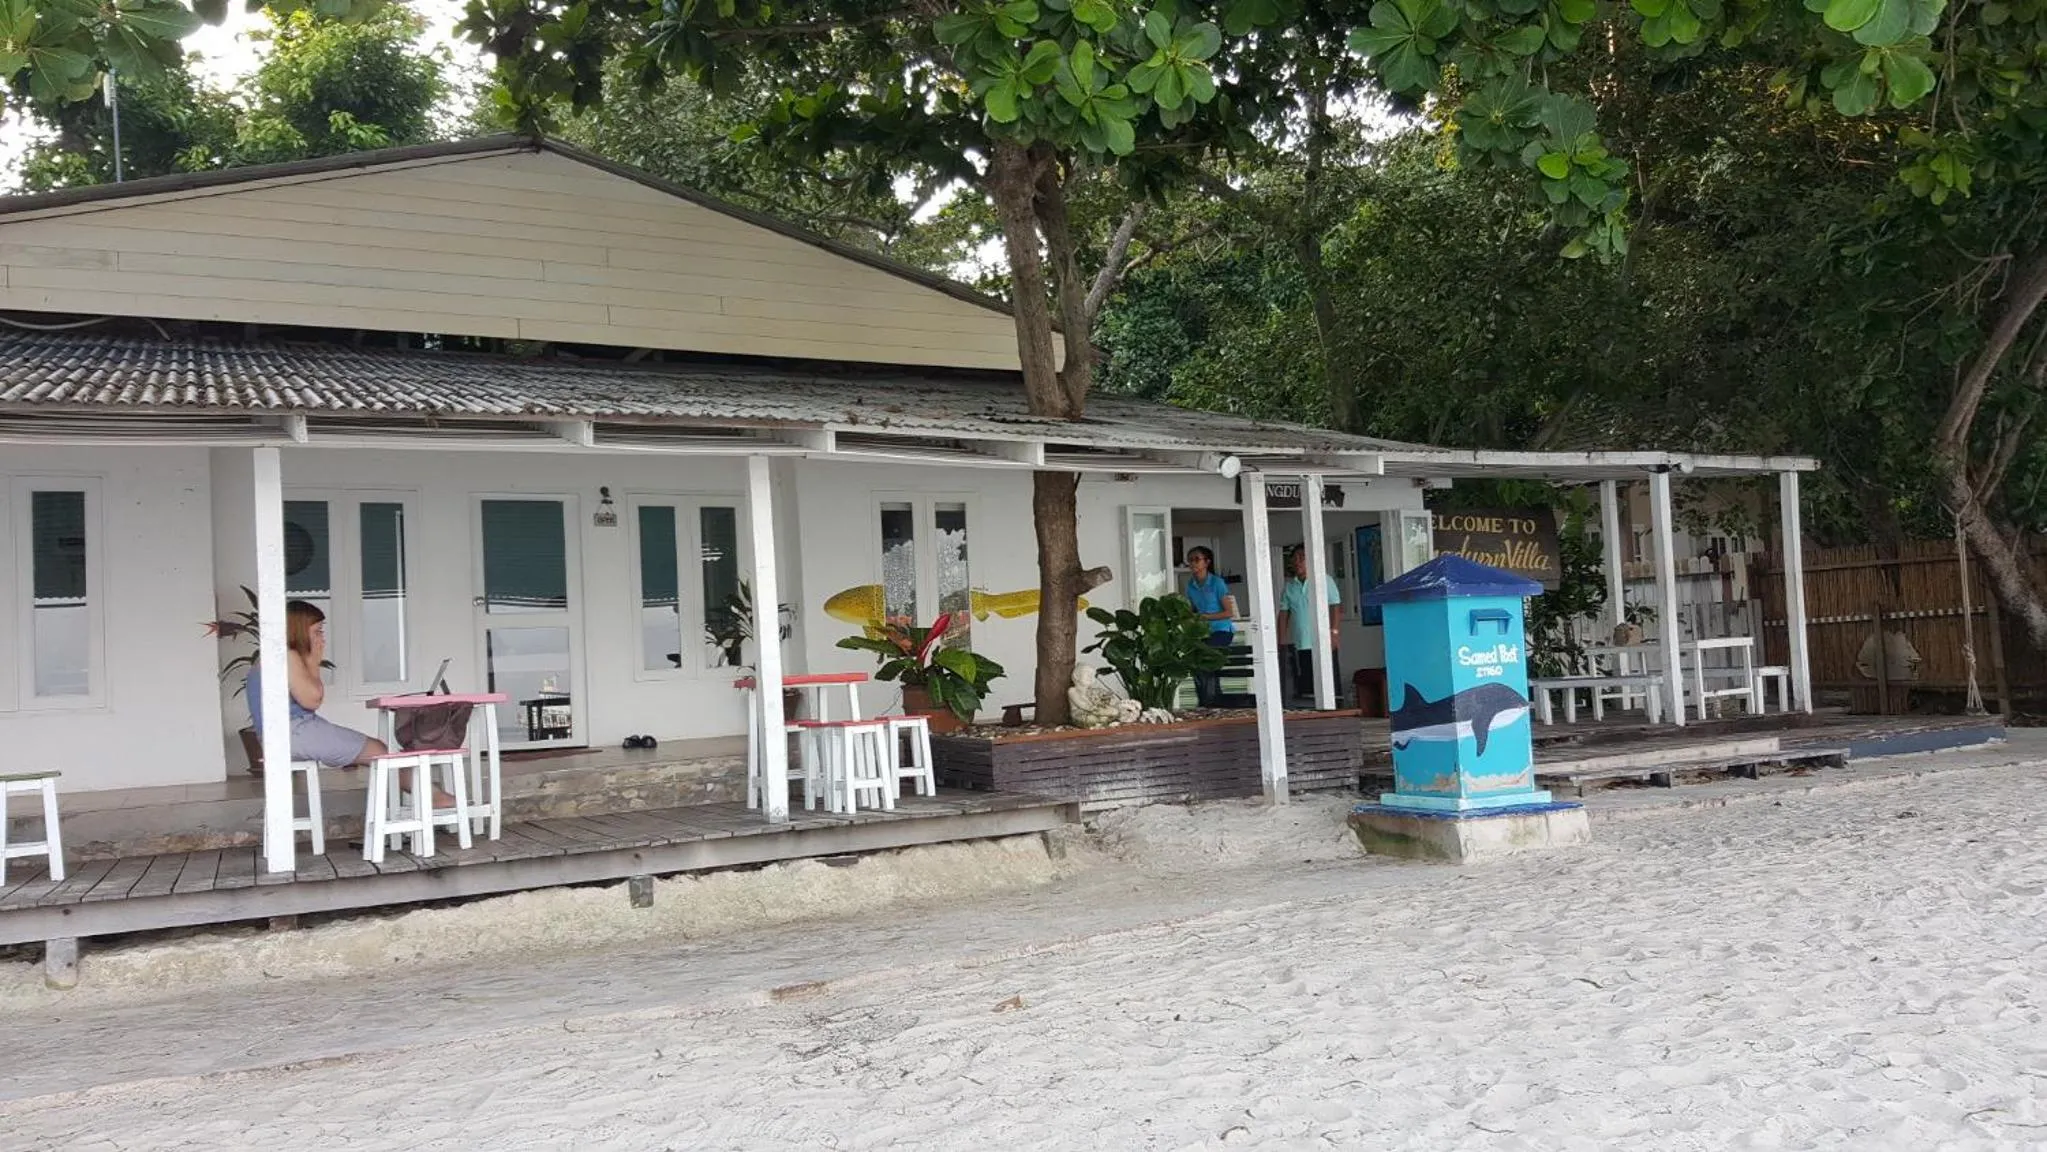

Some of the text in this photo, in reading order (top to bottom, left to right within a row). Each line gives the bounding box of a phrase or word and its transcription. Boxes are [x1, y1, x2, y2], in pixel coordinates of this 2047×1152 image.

[1431, 515, 1536, 534] ELCOME TO
[1458, 643, 1519, 666] Samed Post
